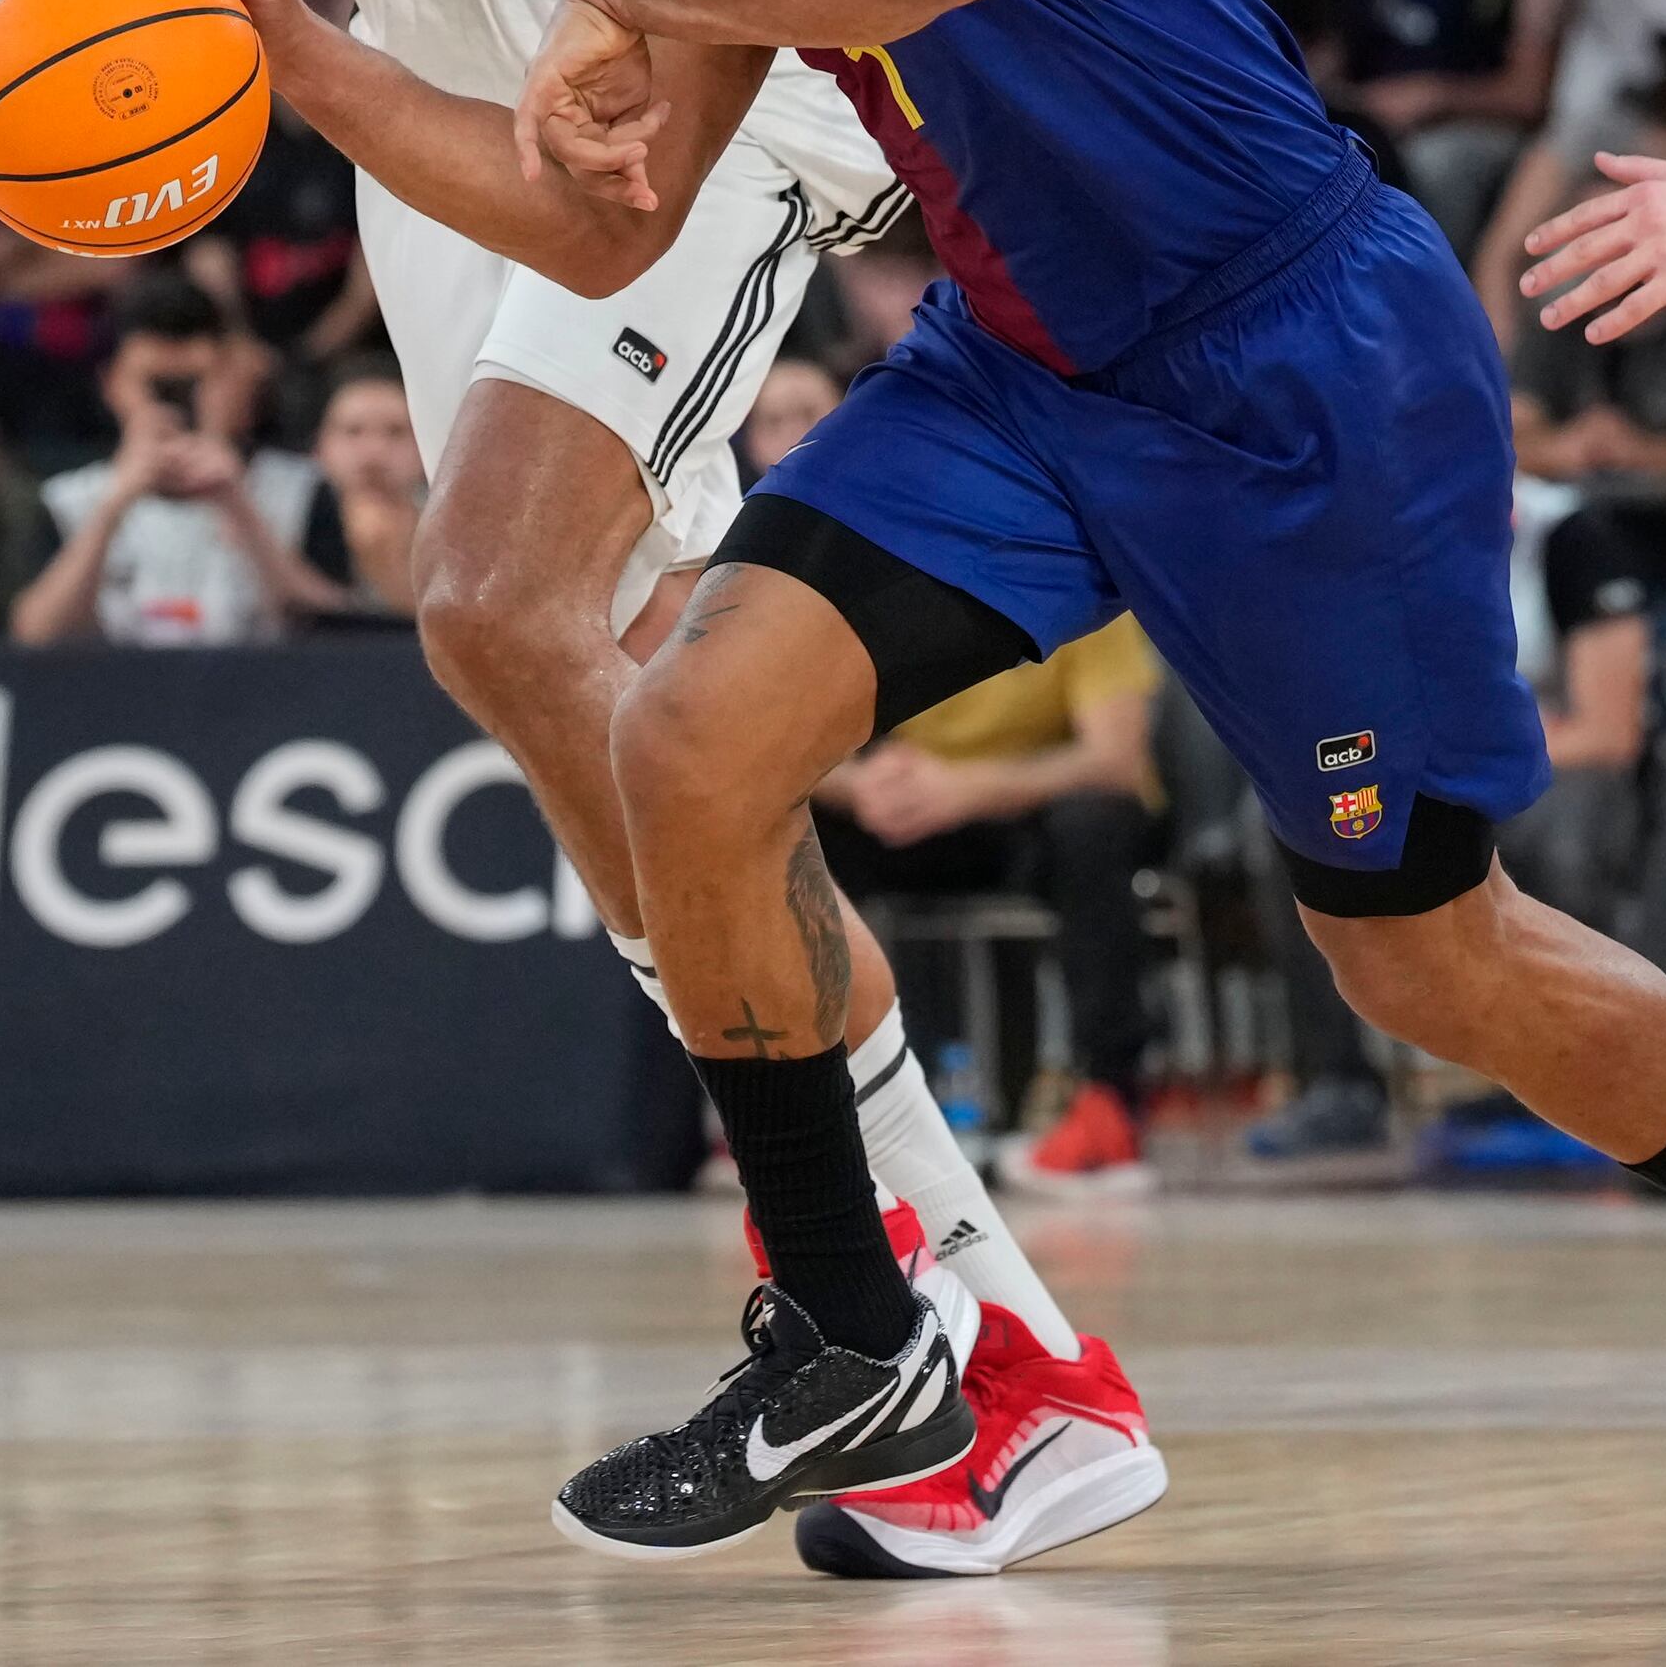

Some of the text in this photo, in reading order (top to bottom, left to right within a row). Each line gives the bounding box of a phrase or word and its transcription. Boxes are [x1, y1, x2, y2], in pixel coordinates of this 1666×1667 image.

[59, 219, 101, 230] NXT
[617, 339, 654, 374] acb
[1323, 746, 1363, 767] acb
[934, 1232, 990, 1262] adidas
